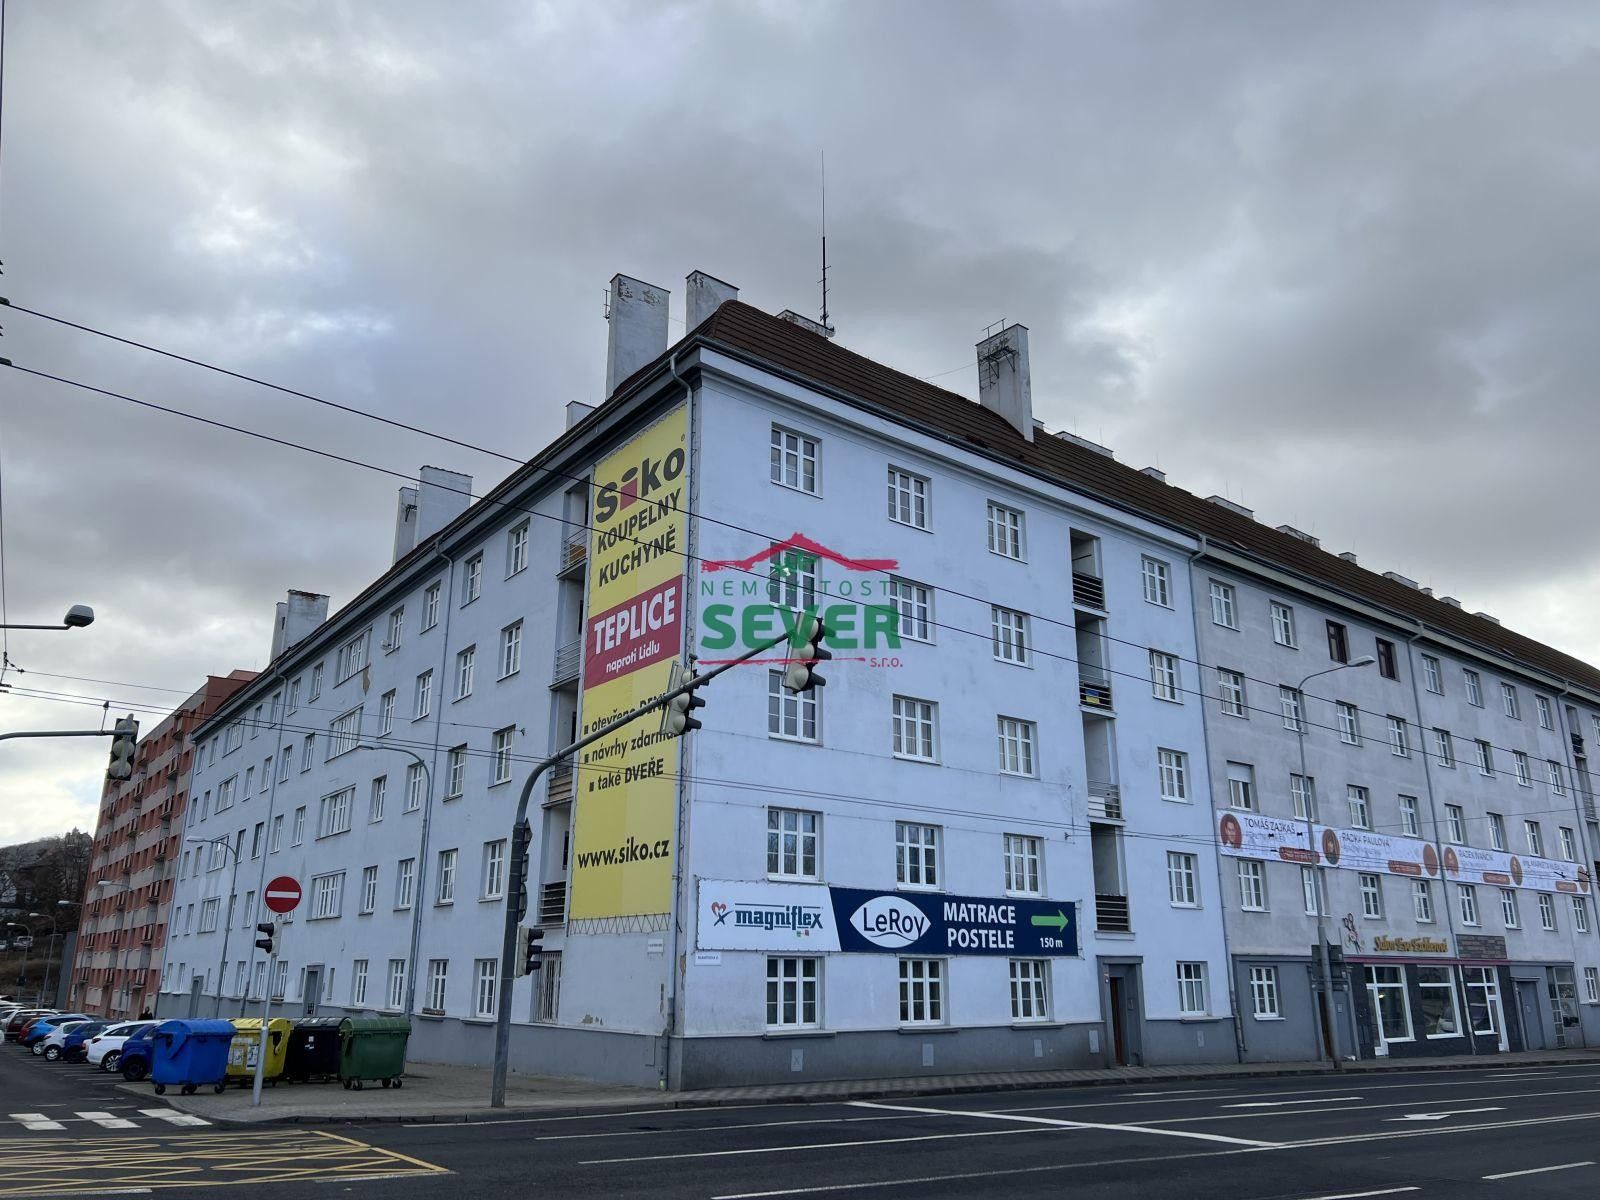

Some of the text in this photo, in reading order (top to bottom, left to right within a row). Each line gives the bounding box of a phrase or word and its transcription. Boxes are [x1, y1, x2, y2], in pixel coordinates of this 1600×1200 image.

[595, 447, 685, 523] siko
[597, 488, 681, 555] KOUPELNY
[599, 524, 677, 587] KUCHYNĚ
[594, 586, 677, 655] TEPLICE
[606, 641, 660, 674] naproti Lidlu
[592, 738, 628, 762] návrhy
[598, 757, 664, 790] také DVEŘE
[577, 836, 670, 869] www.siko.cz
[735, 905, 823, 931] magniflex
[863, 907, 925, 939] LeRoy
[943, 902, 1016, 924] MATRACE
[947, 928, 1015, 949] POSTELE
[1040, 937, 1063, 948] 150 m
